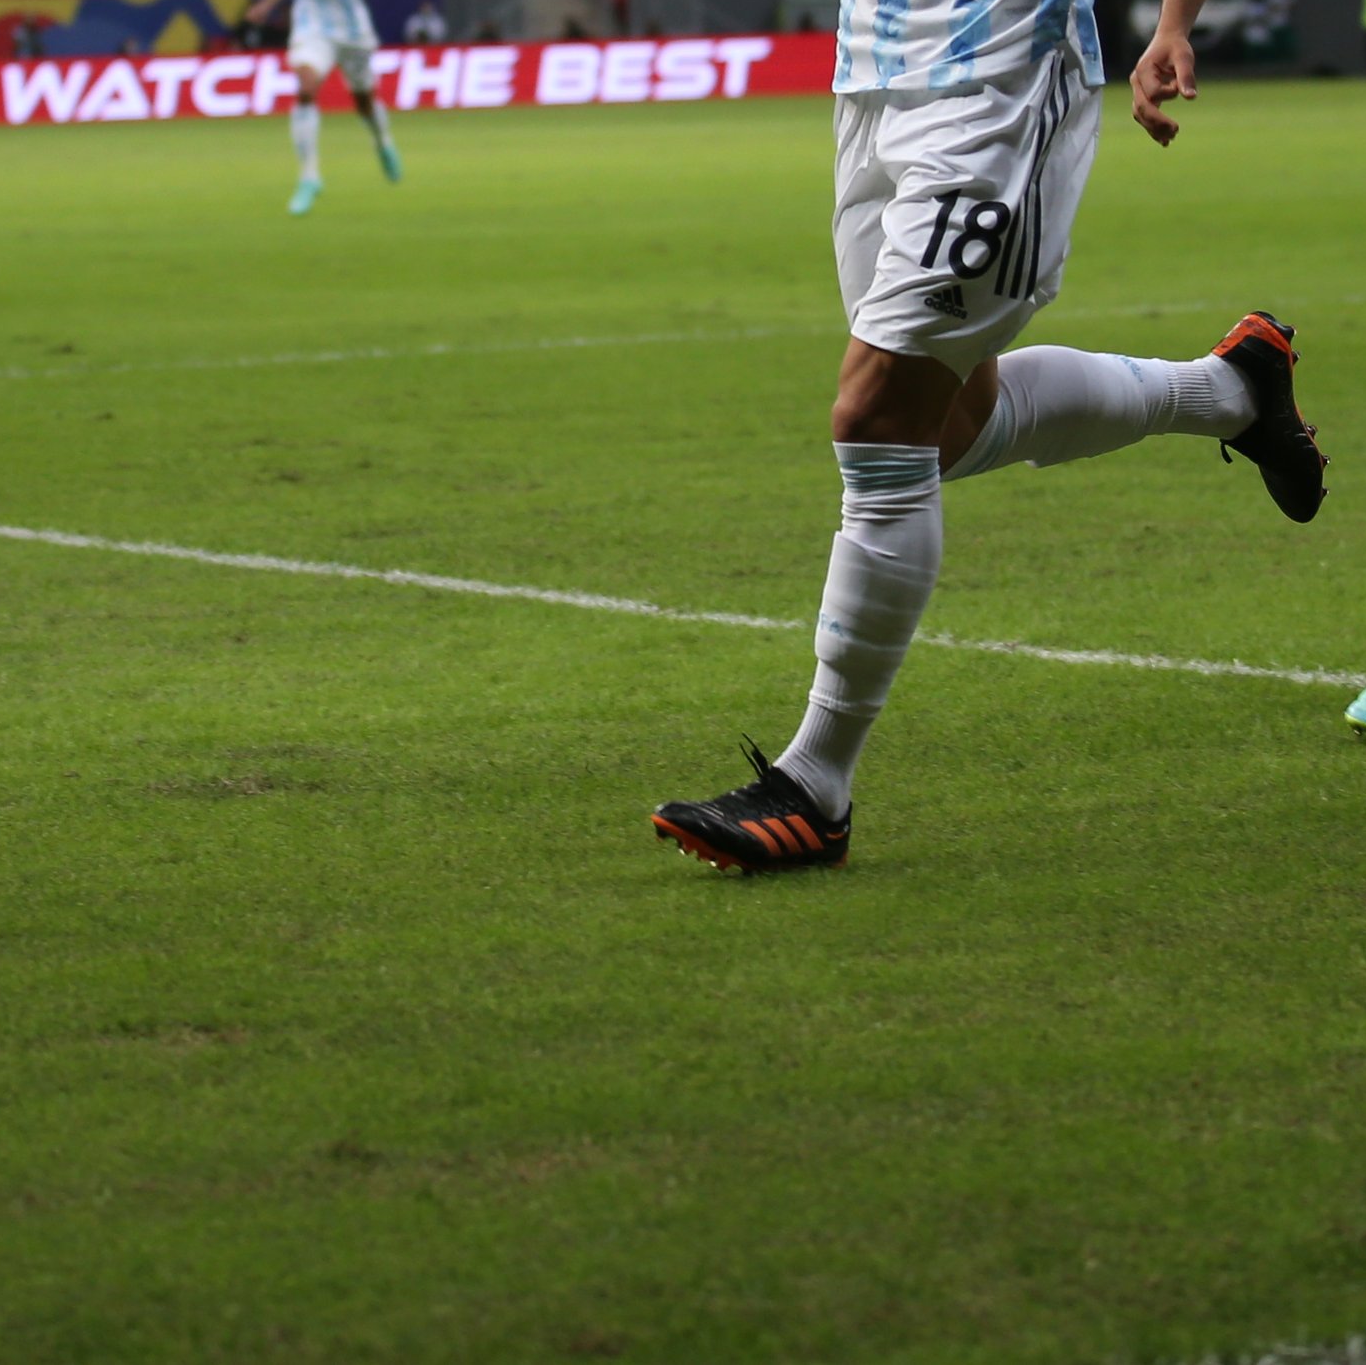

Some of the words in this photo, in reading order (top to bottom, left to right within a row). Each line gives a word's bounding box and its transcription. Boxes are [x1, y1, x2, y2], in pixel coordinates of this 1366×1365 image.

[534, 36, 774, 106] BEST
[920, 187, 1012, 280] 18
[924, 296, 968, 320] adidas
